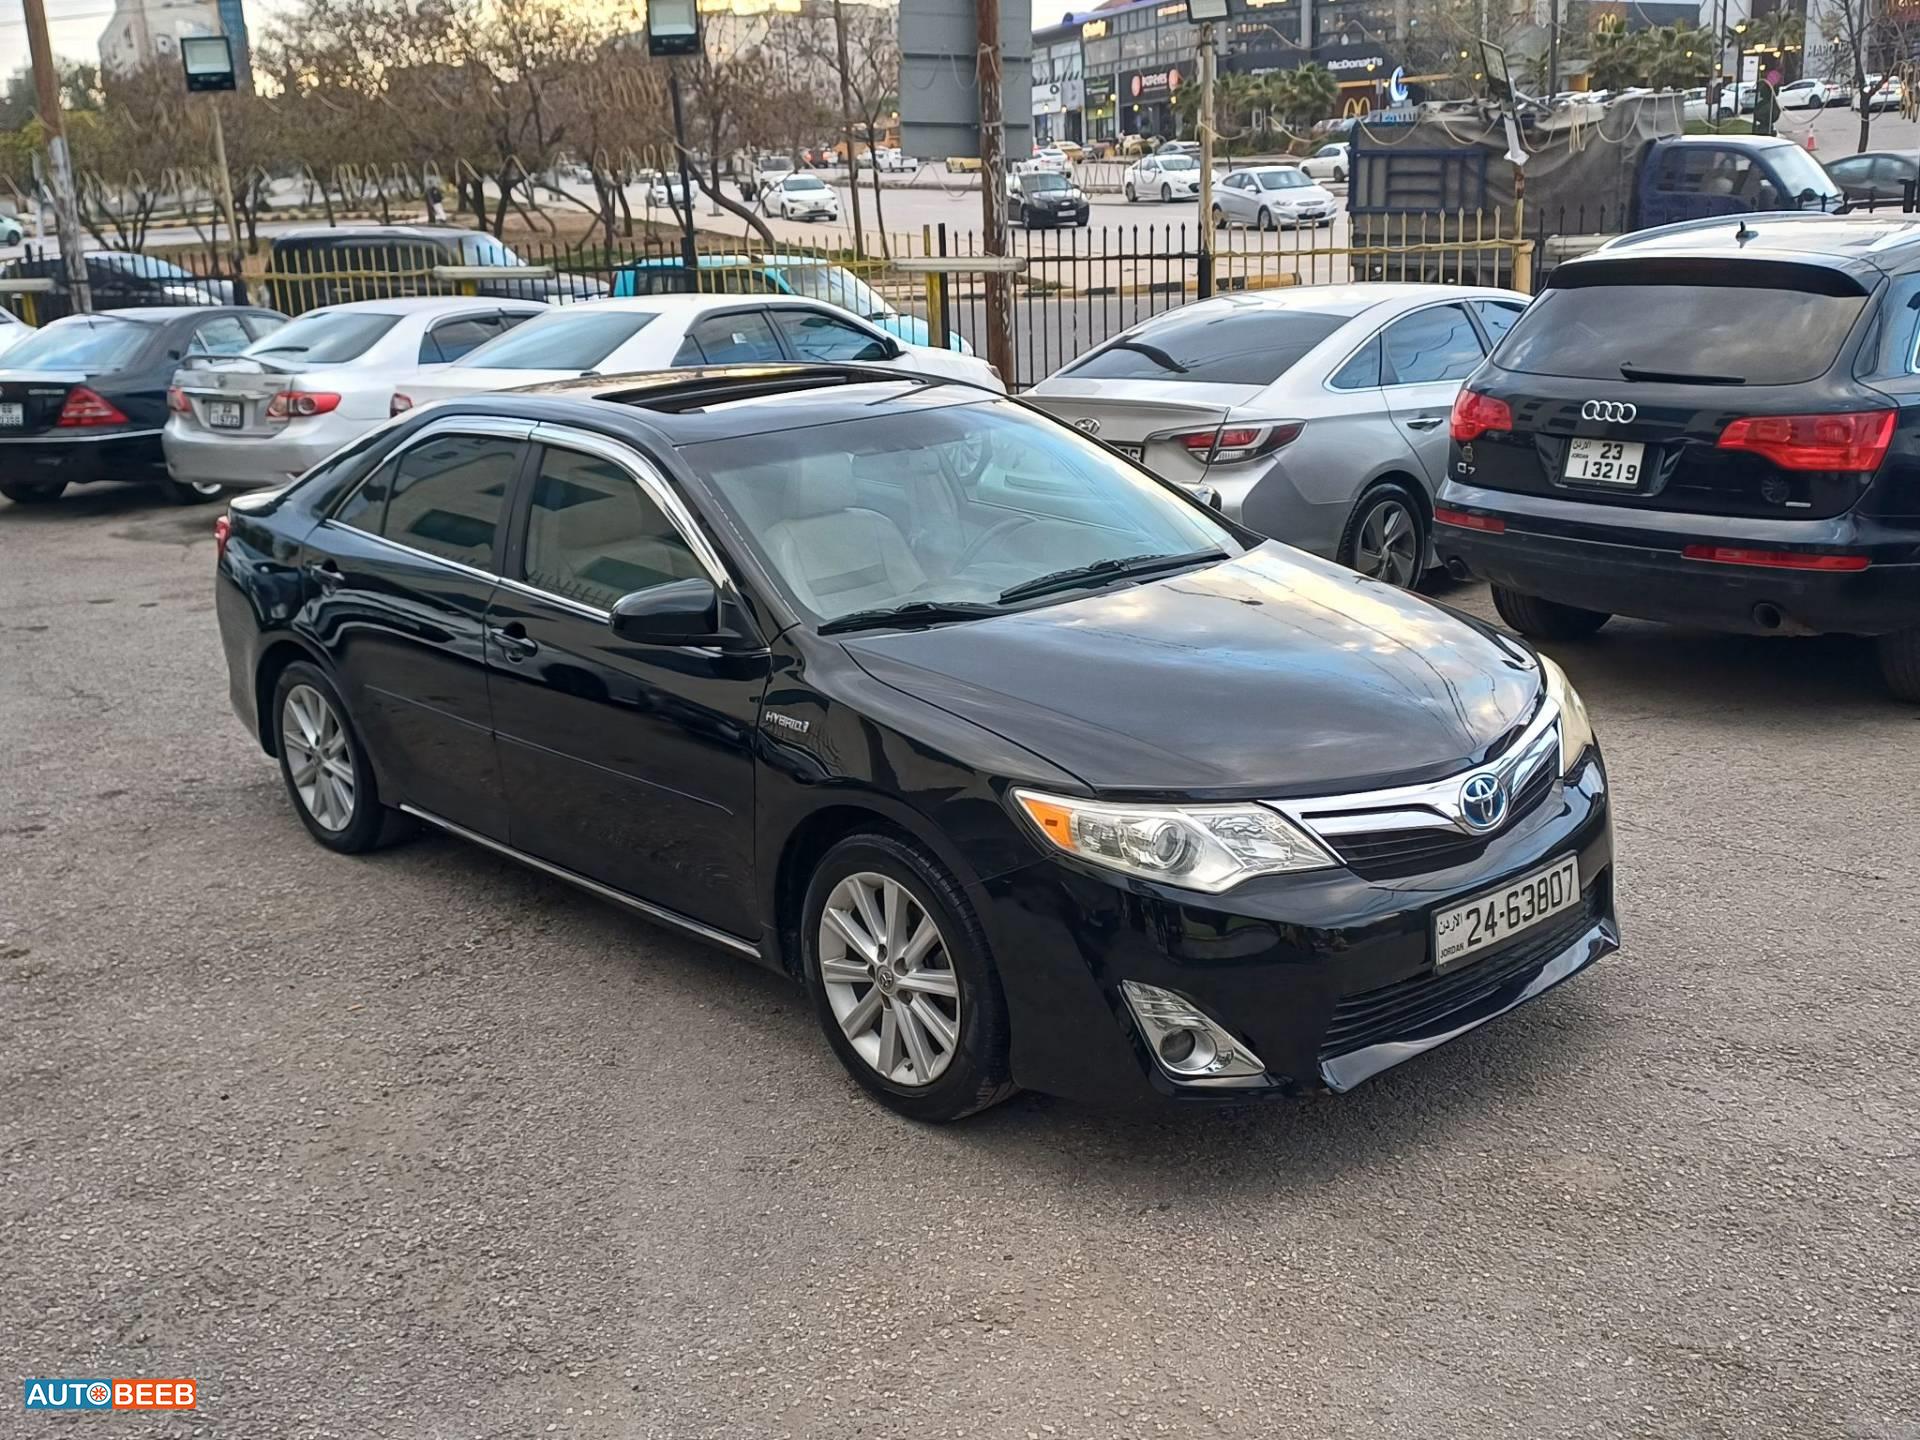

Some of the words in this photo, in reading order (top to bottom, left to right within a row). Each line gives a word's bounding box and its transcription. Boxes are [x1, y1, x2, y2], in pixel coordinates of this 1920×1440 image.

[1327, 57, 1383, 70] McDonald's
[1600, 442, 1624, 460] 23
[1582, 460, 1637, 481] 13219
[765, 711, 802, 731] HYBRID
[1465, 863, 1573, 947] 24-63807
[1440, 943, 1464, 958] JORDAN
